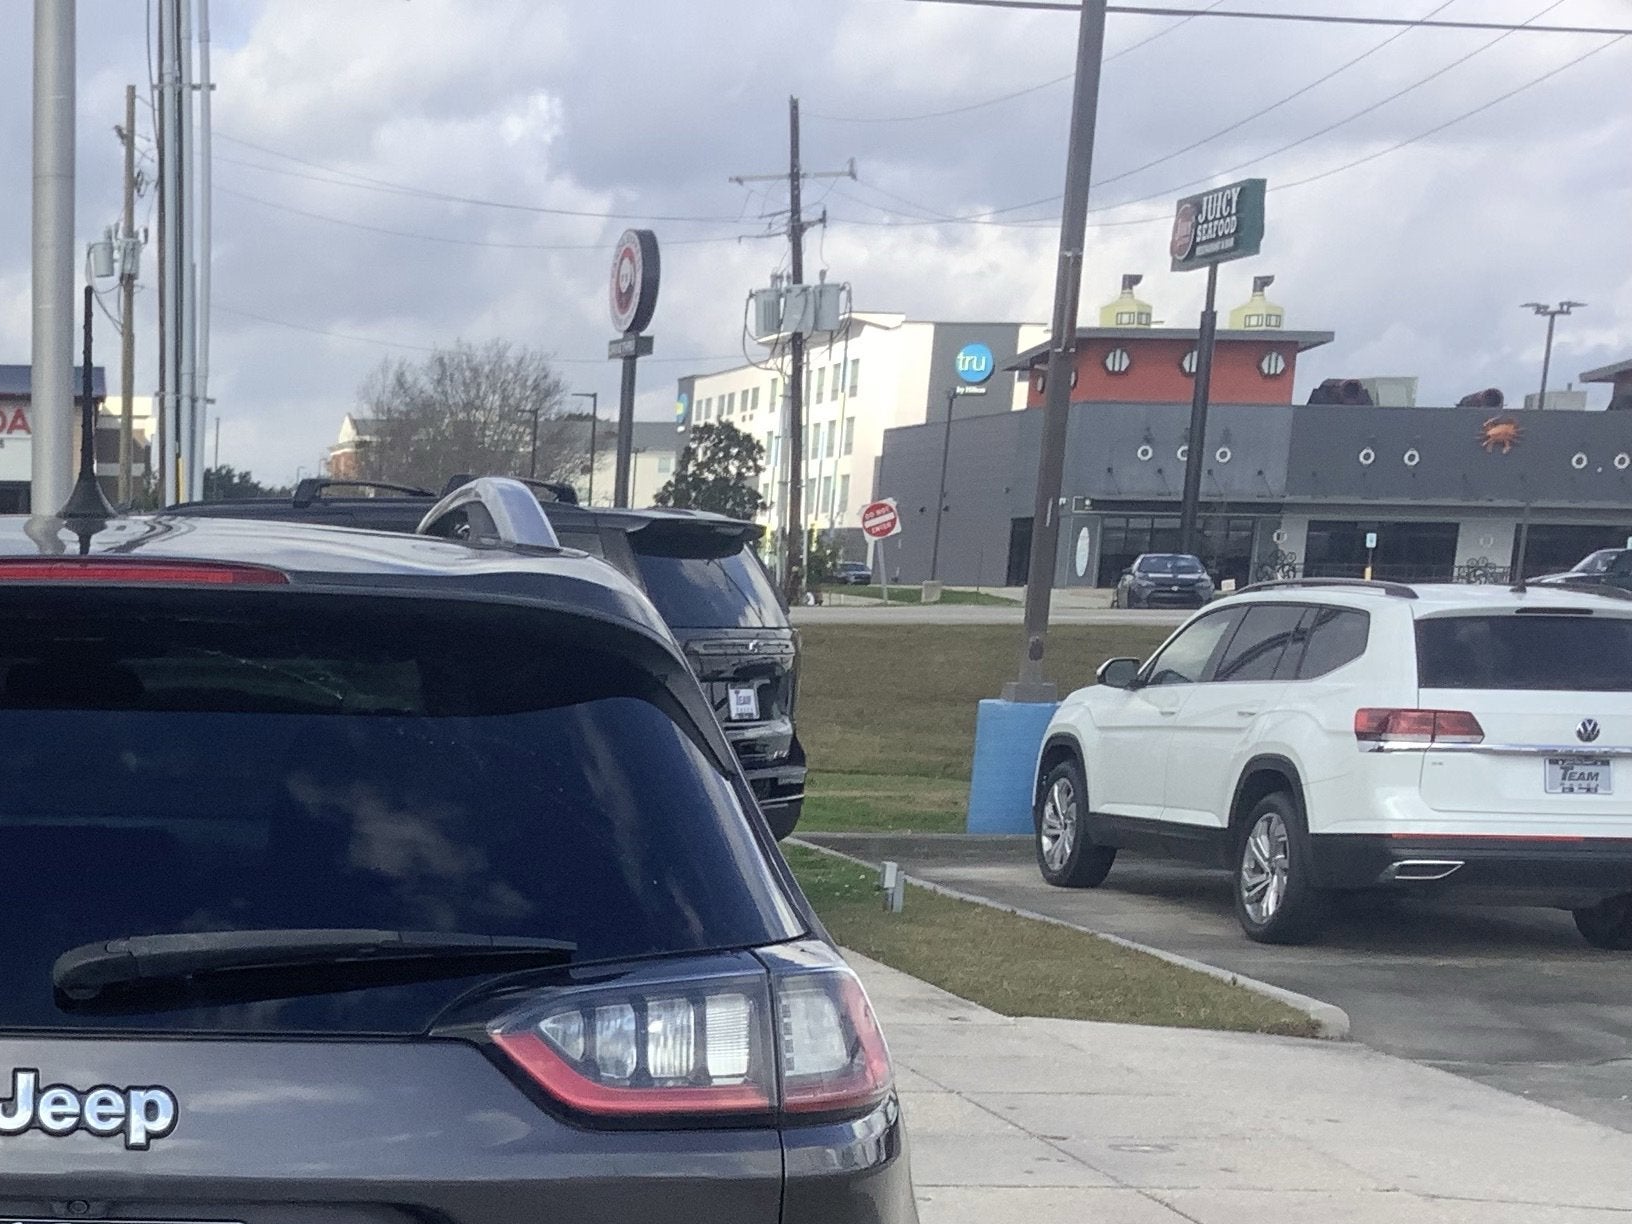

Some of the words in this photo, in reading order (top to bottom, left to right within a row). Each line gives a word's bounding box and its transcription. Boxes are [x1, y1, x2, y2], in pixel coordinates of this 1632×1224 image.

[1198, 186, 1241, 223] JUICY
[1196, 215, 1237, 243] SEAFOOD
[957, 351, 986, 371] tru
[1560, 765, 1599, 781] TEAM
